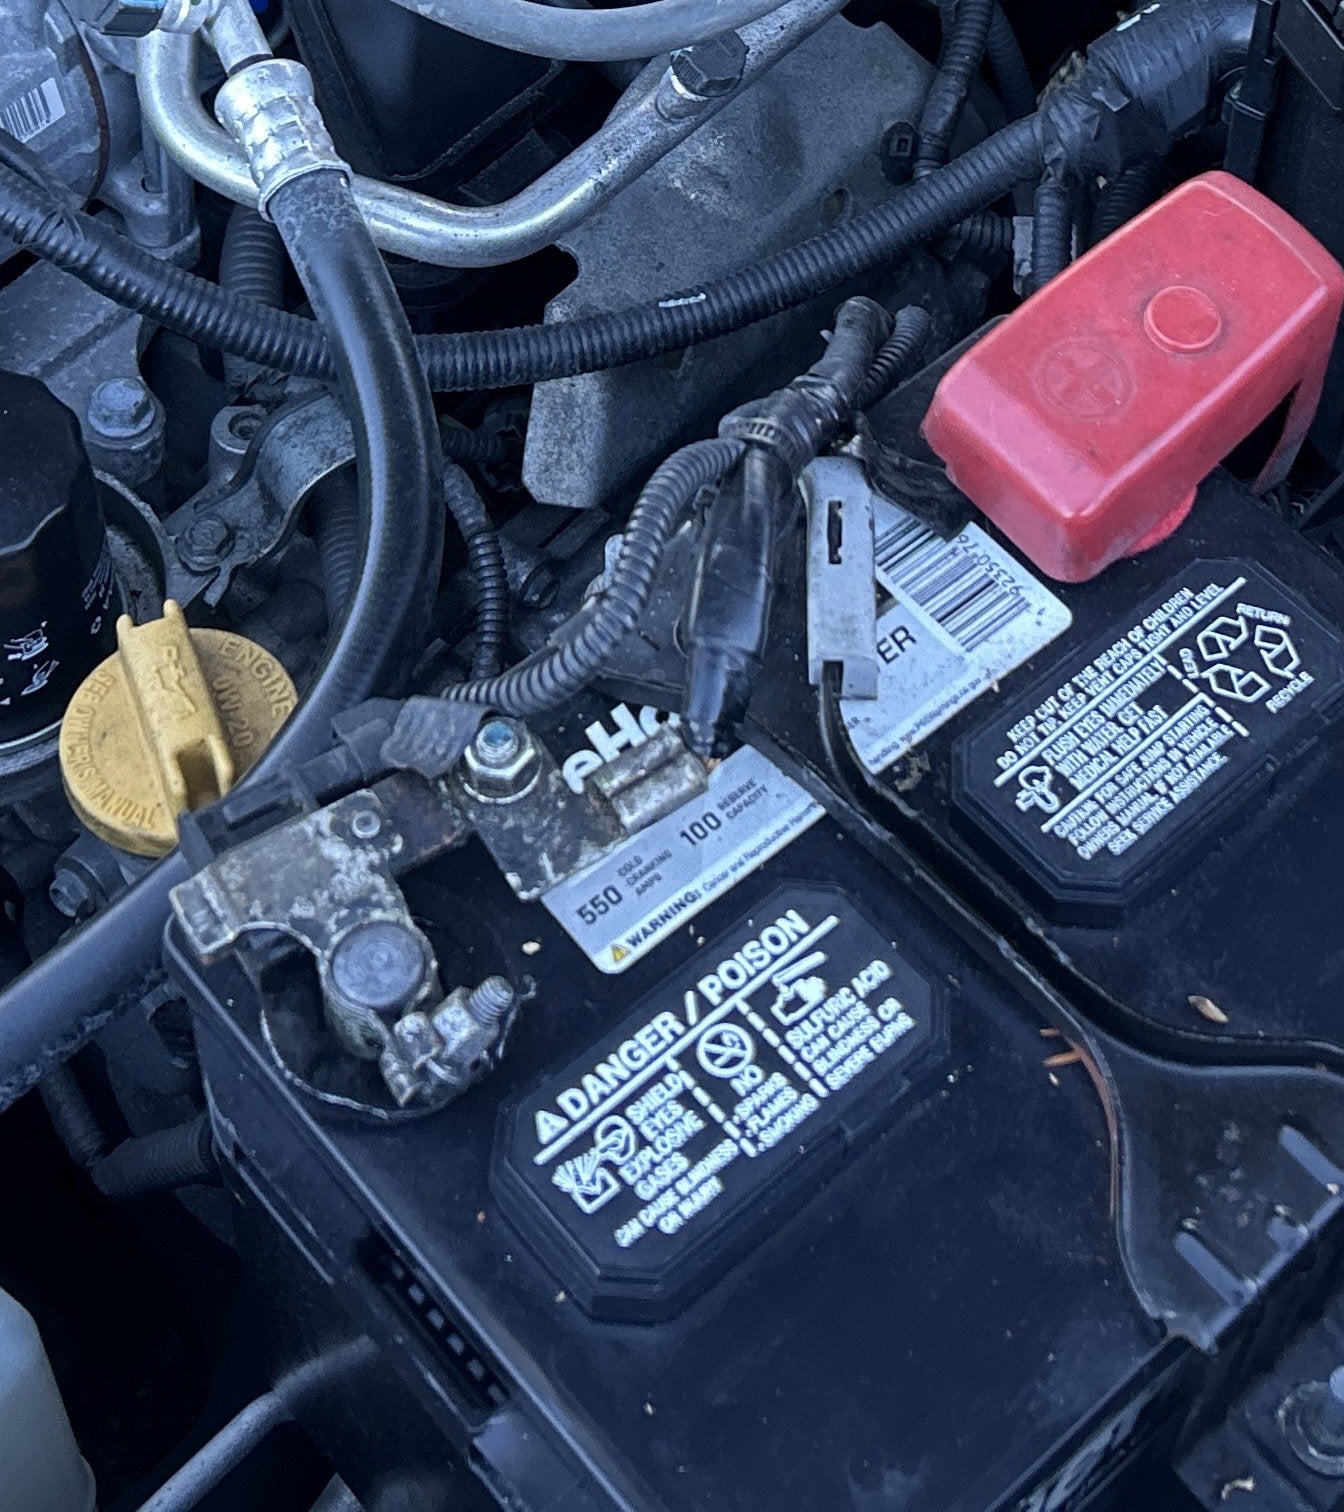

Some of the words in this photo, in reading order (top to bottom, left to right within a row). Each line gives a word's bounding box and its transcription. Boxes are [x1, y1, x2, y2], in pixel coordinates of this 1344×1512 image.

[1236, 602, 1291, 626] RETURN
[218, 636, 298, 719] ENGINE
[996, 749, 1018, 770] DO
[1014, 731, 1040, 755] NOT
[1057, 690, 1088, 719] KEEP
[1084, 669, 1114, 697] VENT
[1111, 646, 1142, 675] CAPS
[1138, 622, 1171, 653] TIGHT
[1168, 604, 1193, 627] AND
[1190, 583, 1225, 610] LEVEL
[1007, 714, 1038, 743] KEEP
[1033, 695, 1060, 721] OUT
[1056, 683, 1076, 702] OF
[1072, 664, 1098, 689] THE
[1093, 636, 1131, 671] REACH
[1127, 625, 1146, 643] OF
[1141, 584, 1193, 632] CHILDREN
[1179, 648, 1201, 679] LEAD
[1265, 671, 1315, 714] RECYCLE
[1041, 729, 1080, 766] FLUSH
[1073, 708, 1106, 739] EYES
[1054, 746, 1088, 779] WITH
[1117, 701, 1143, 727] GET
[1068, 745, 1119, 791] MEDICAL
[1110, 725, 1143, 756] HELP
[1136, 704, 1168, 734] FAST
[1093, 779, 1119, 804] FOR
[1114, 760, 1142, 787] SAFE
[1137, 739, 1166, 767] JUMP
[1161, 702, 1210, 747] STARTING
[1164, 762, 1188, 785] NOT
[1184, 723, 1234, 768] AVAILABLE
[725, 784, 768, 820] CAPACITY
[1068, 808, 1109, 846] FOLLOW
[1104, 755, 1172, 816] INSTRUCTIONS
[1178, 716, 1219, 754] VEHICLE
[679, 809, 722, 848] 100
[1106, 826, 1137, 856] SEEK
[1131, 795, 1175, 835] SERVICE
[576, 884, 623, 925] 550
[627, 886, 702, 947] WARNING:
[557, 1011, 686, 1122] DANGER
[697, 909, 810, 1006] POISON
[783, 984, 858, 1051] SULFURIC
[851, 959, 893, 999] ACID
[798, 1032, 831, 1063] CAN
[825, 999, 871, 1041] CAUSE
[623, 1069, 687, 1127] SHIELD
[730, 1065, 766, 1097] NO
[617, 1109, 705, 1186] EXPLOSIVE
[637, 1097, 686, 1141] EYES
[632, 1149, 691, 1203] GASES
